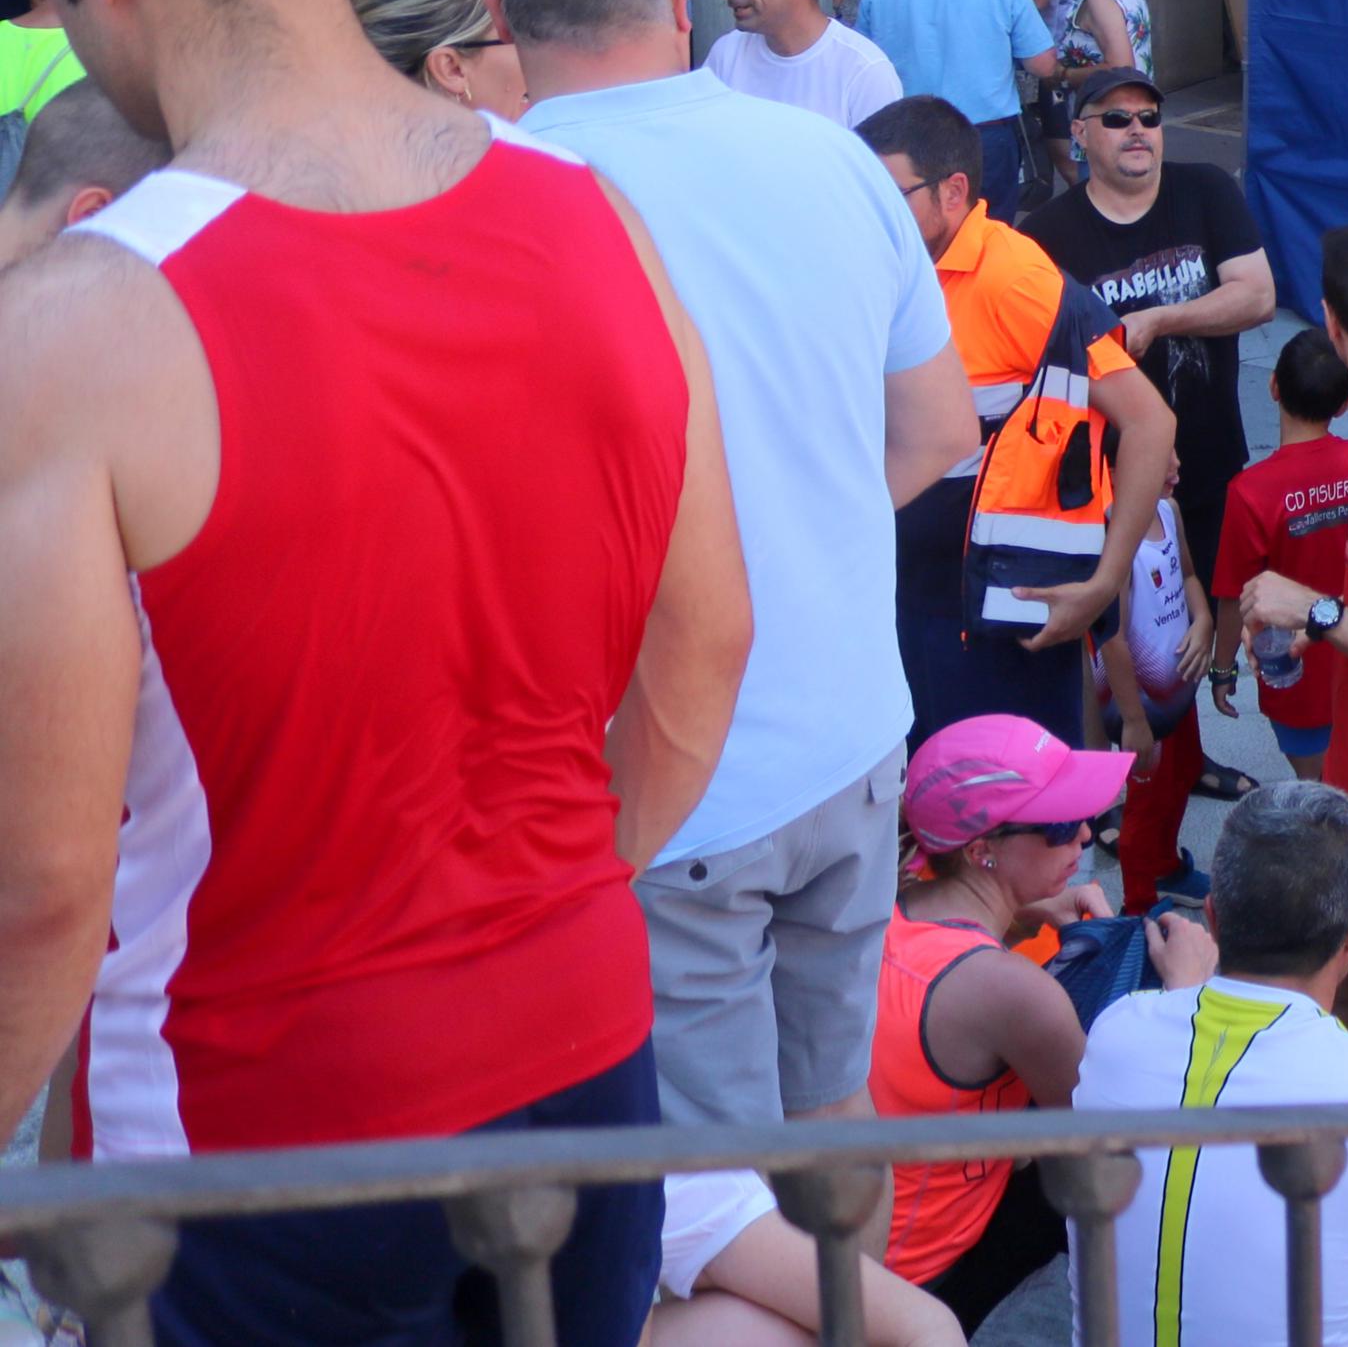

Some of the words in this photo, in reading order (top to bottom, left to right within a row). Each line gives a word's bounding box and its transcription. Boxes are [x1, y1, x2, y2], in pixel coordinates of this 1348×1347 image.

[1284, 491, 1305, 512] CD
[1304, 509, 1337, 526] Talleres
[1154, 610, 1181, 628] Venta
